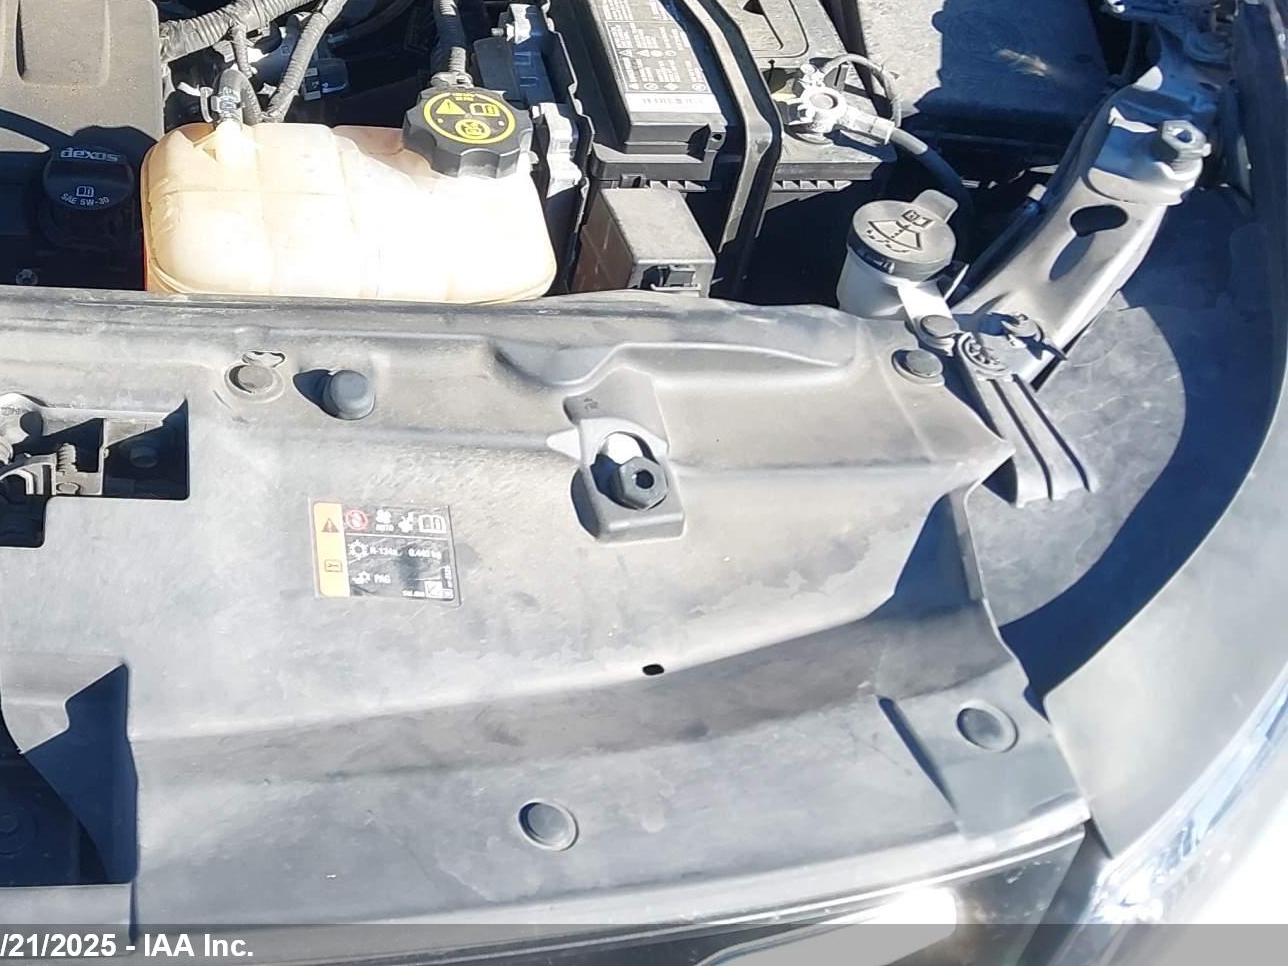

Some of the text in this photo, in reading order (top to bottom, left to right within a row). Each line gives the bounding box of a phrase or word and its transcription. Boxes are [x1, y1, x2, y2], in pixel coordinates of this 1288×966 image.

[60, 146, 121, 163] dexos
[61, 193, 110, 207] SAE 5W-30
